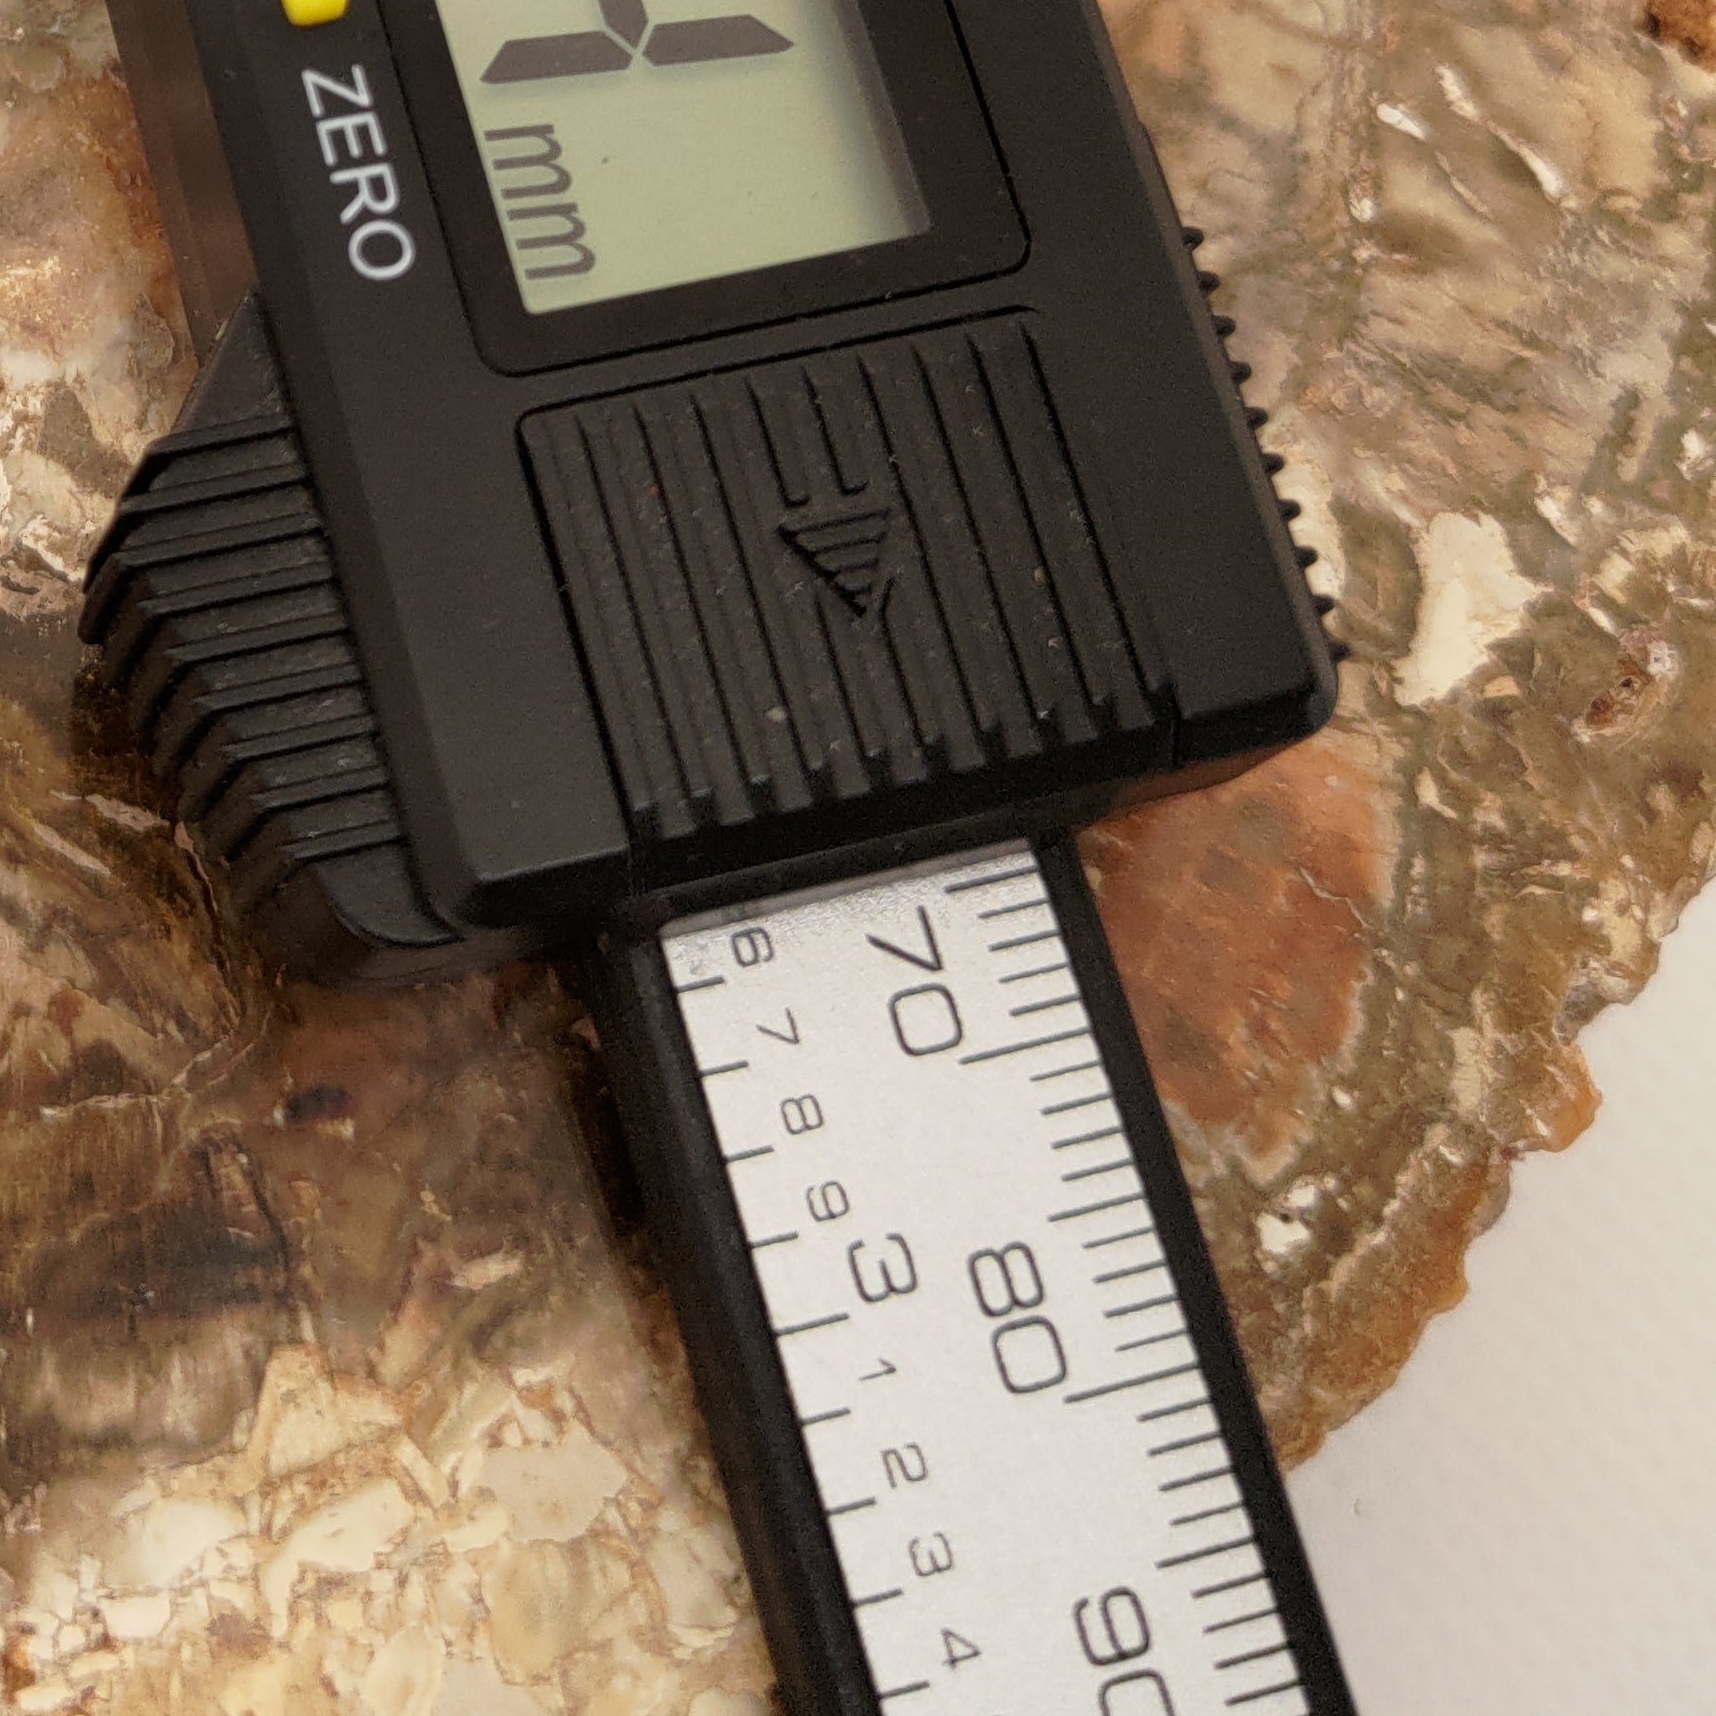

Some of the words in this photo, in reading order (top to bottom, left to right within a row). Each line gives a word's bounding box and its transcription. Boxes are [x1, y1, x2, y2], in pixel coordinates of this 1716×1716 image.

[301, 64, 416, 281] ZERO
[484, 124, 596, 280] mm
[730, 926, 775, 968] 6
[867, 905, 963, 1056] 70
[757, 1008, 800, 1046] 7
[780, 1093, 824, 1136] 8
[807, 1180, 850, 1222] 9
[847, 1233, 918, 1303] 3
[967, 1241, 1067, 1394] 80
[858, 1357, 897, 1381] 1
[881, 1443, 928, 1488] 2
[908, 1532, 954, 1578] 3
[940, 1628, 982, 1670] 4
